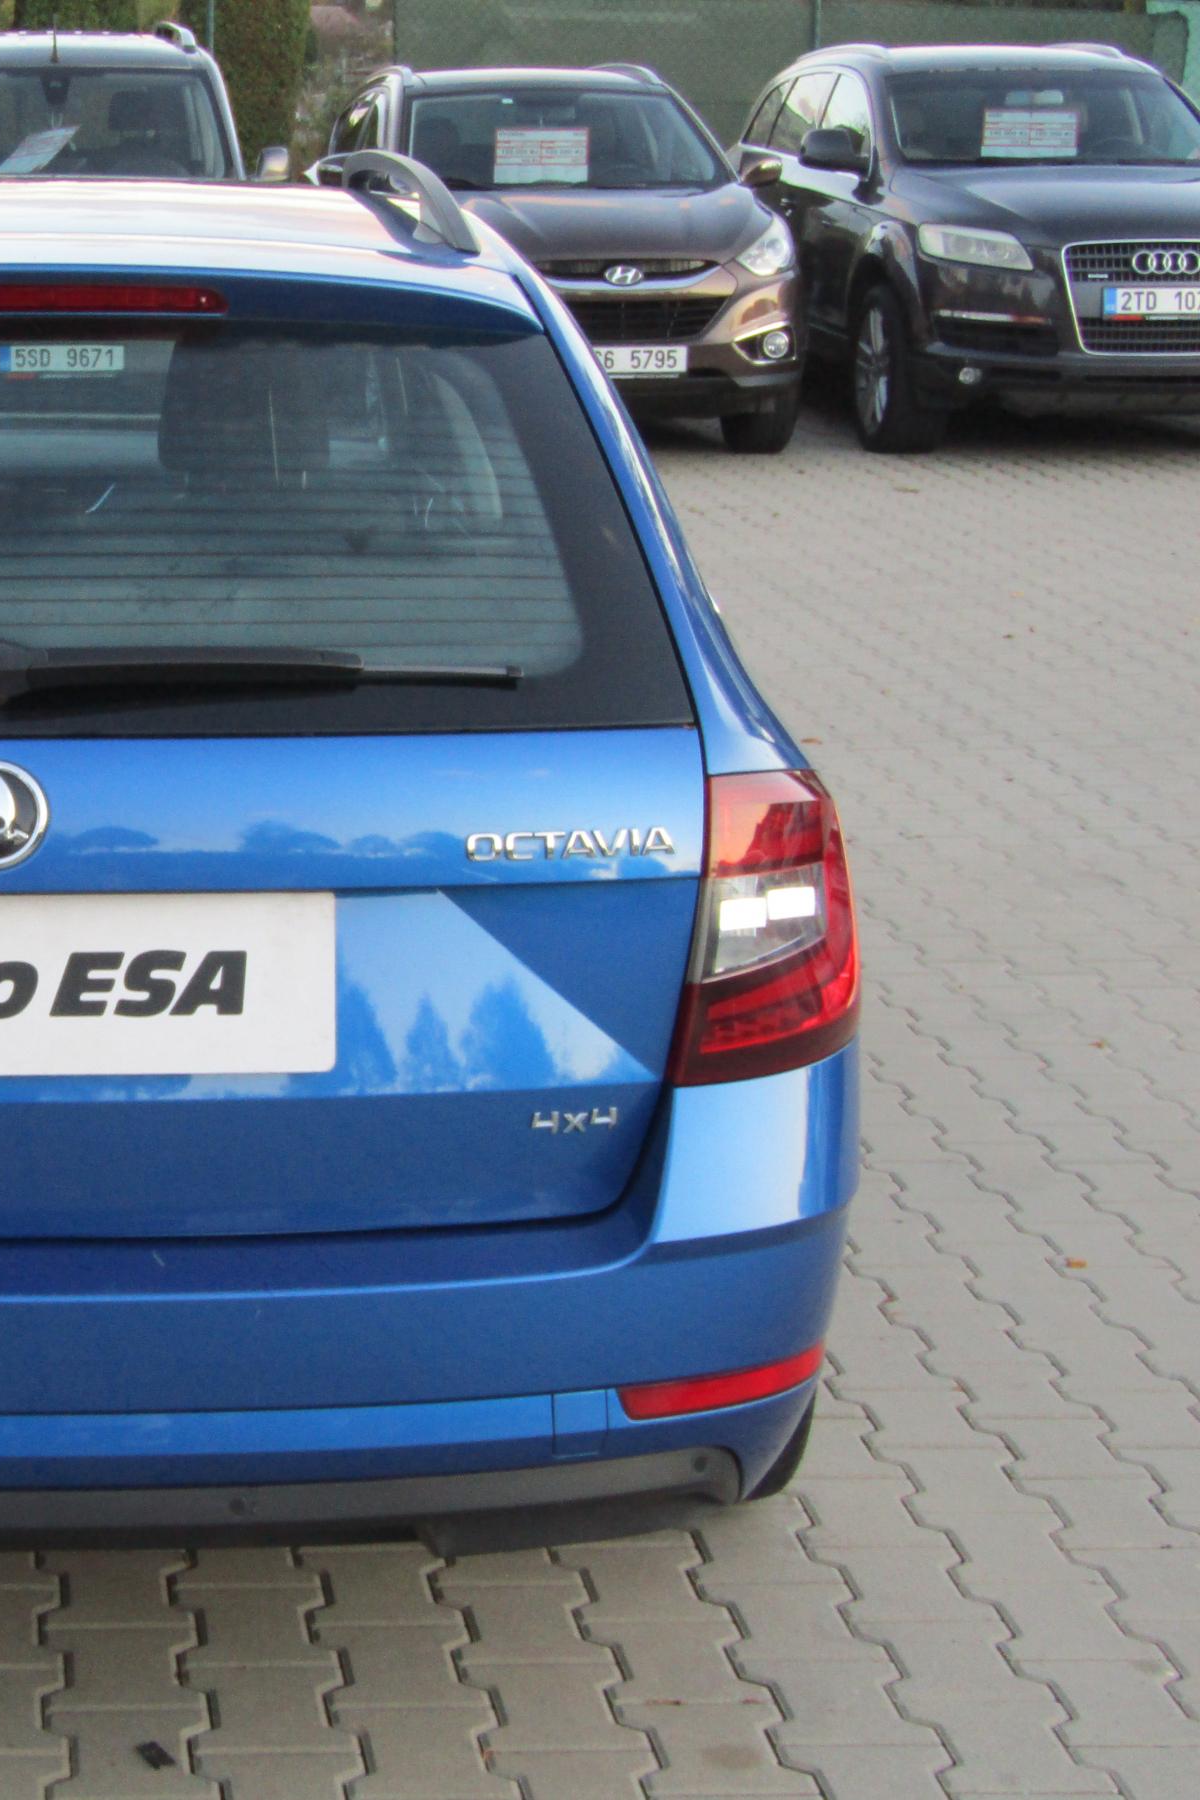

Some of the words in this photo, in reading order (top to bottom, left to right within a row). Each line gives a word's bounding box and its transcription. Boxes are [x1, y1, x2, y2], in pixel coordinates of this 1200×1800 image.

[1121, 291, 1157, 311] 2TD
[1174, 291, 1200, 311] 10
[14, 348, 51, 367] 5SD
[66, 348, 114, 367] 9671
[630, 349, 677, 369] 5795
[466, 826, 675, 862] OCTAVIA
[49, 949, 247, 1018] ESA
[531, 1107, 618, 1135] 4x4
